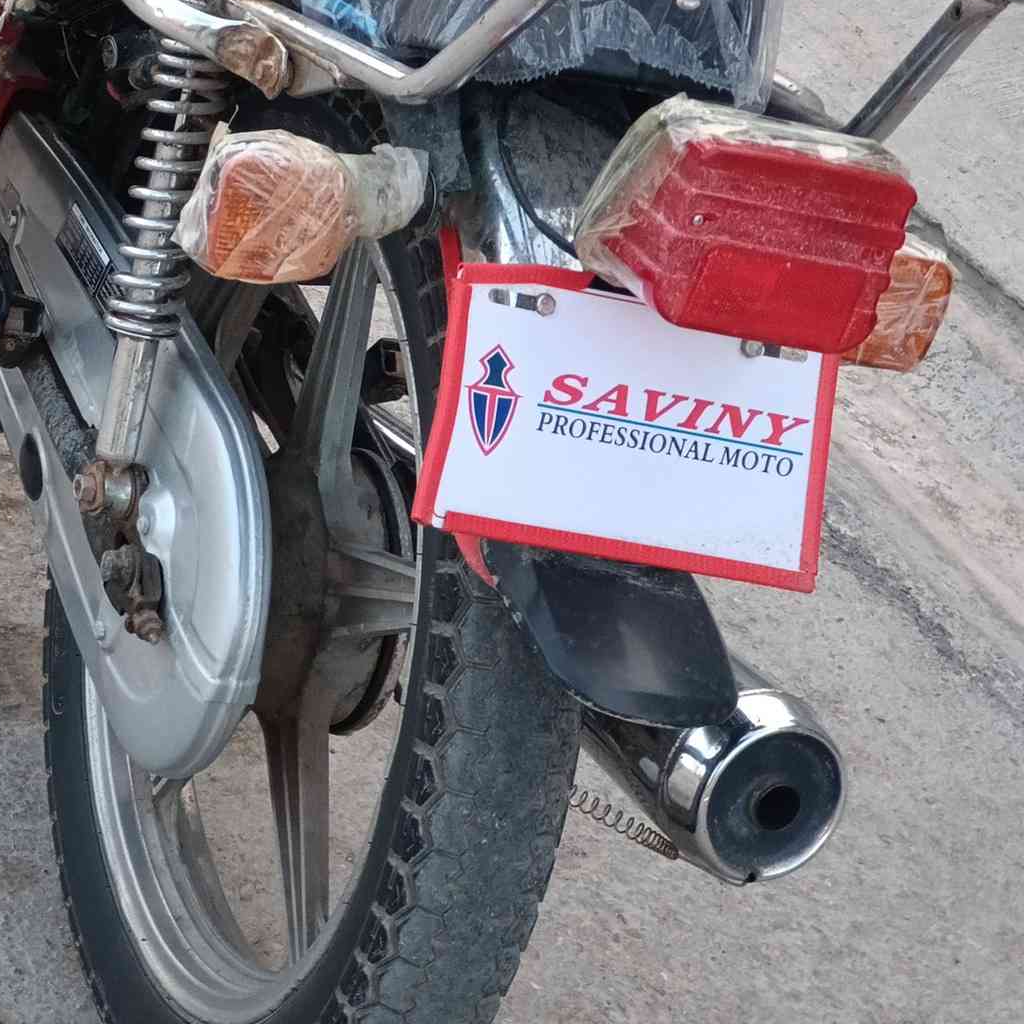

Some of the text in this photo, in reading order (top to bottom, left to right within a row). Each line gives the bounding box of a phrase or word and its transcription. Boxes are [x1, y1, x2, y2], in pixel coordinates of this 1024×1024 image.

[543, 374, 809, 445] SAVINY
[536, 412, 794, 477] PROFESSIONAL MOTO
